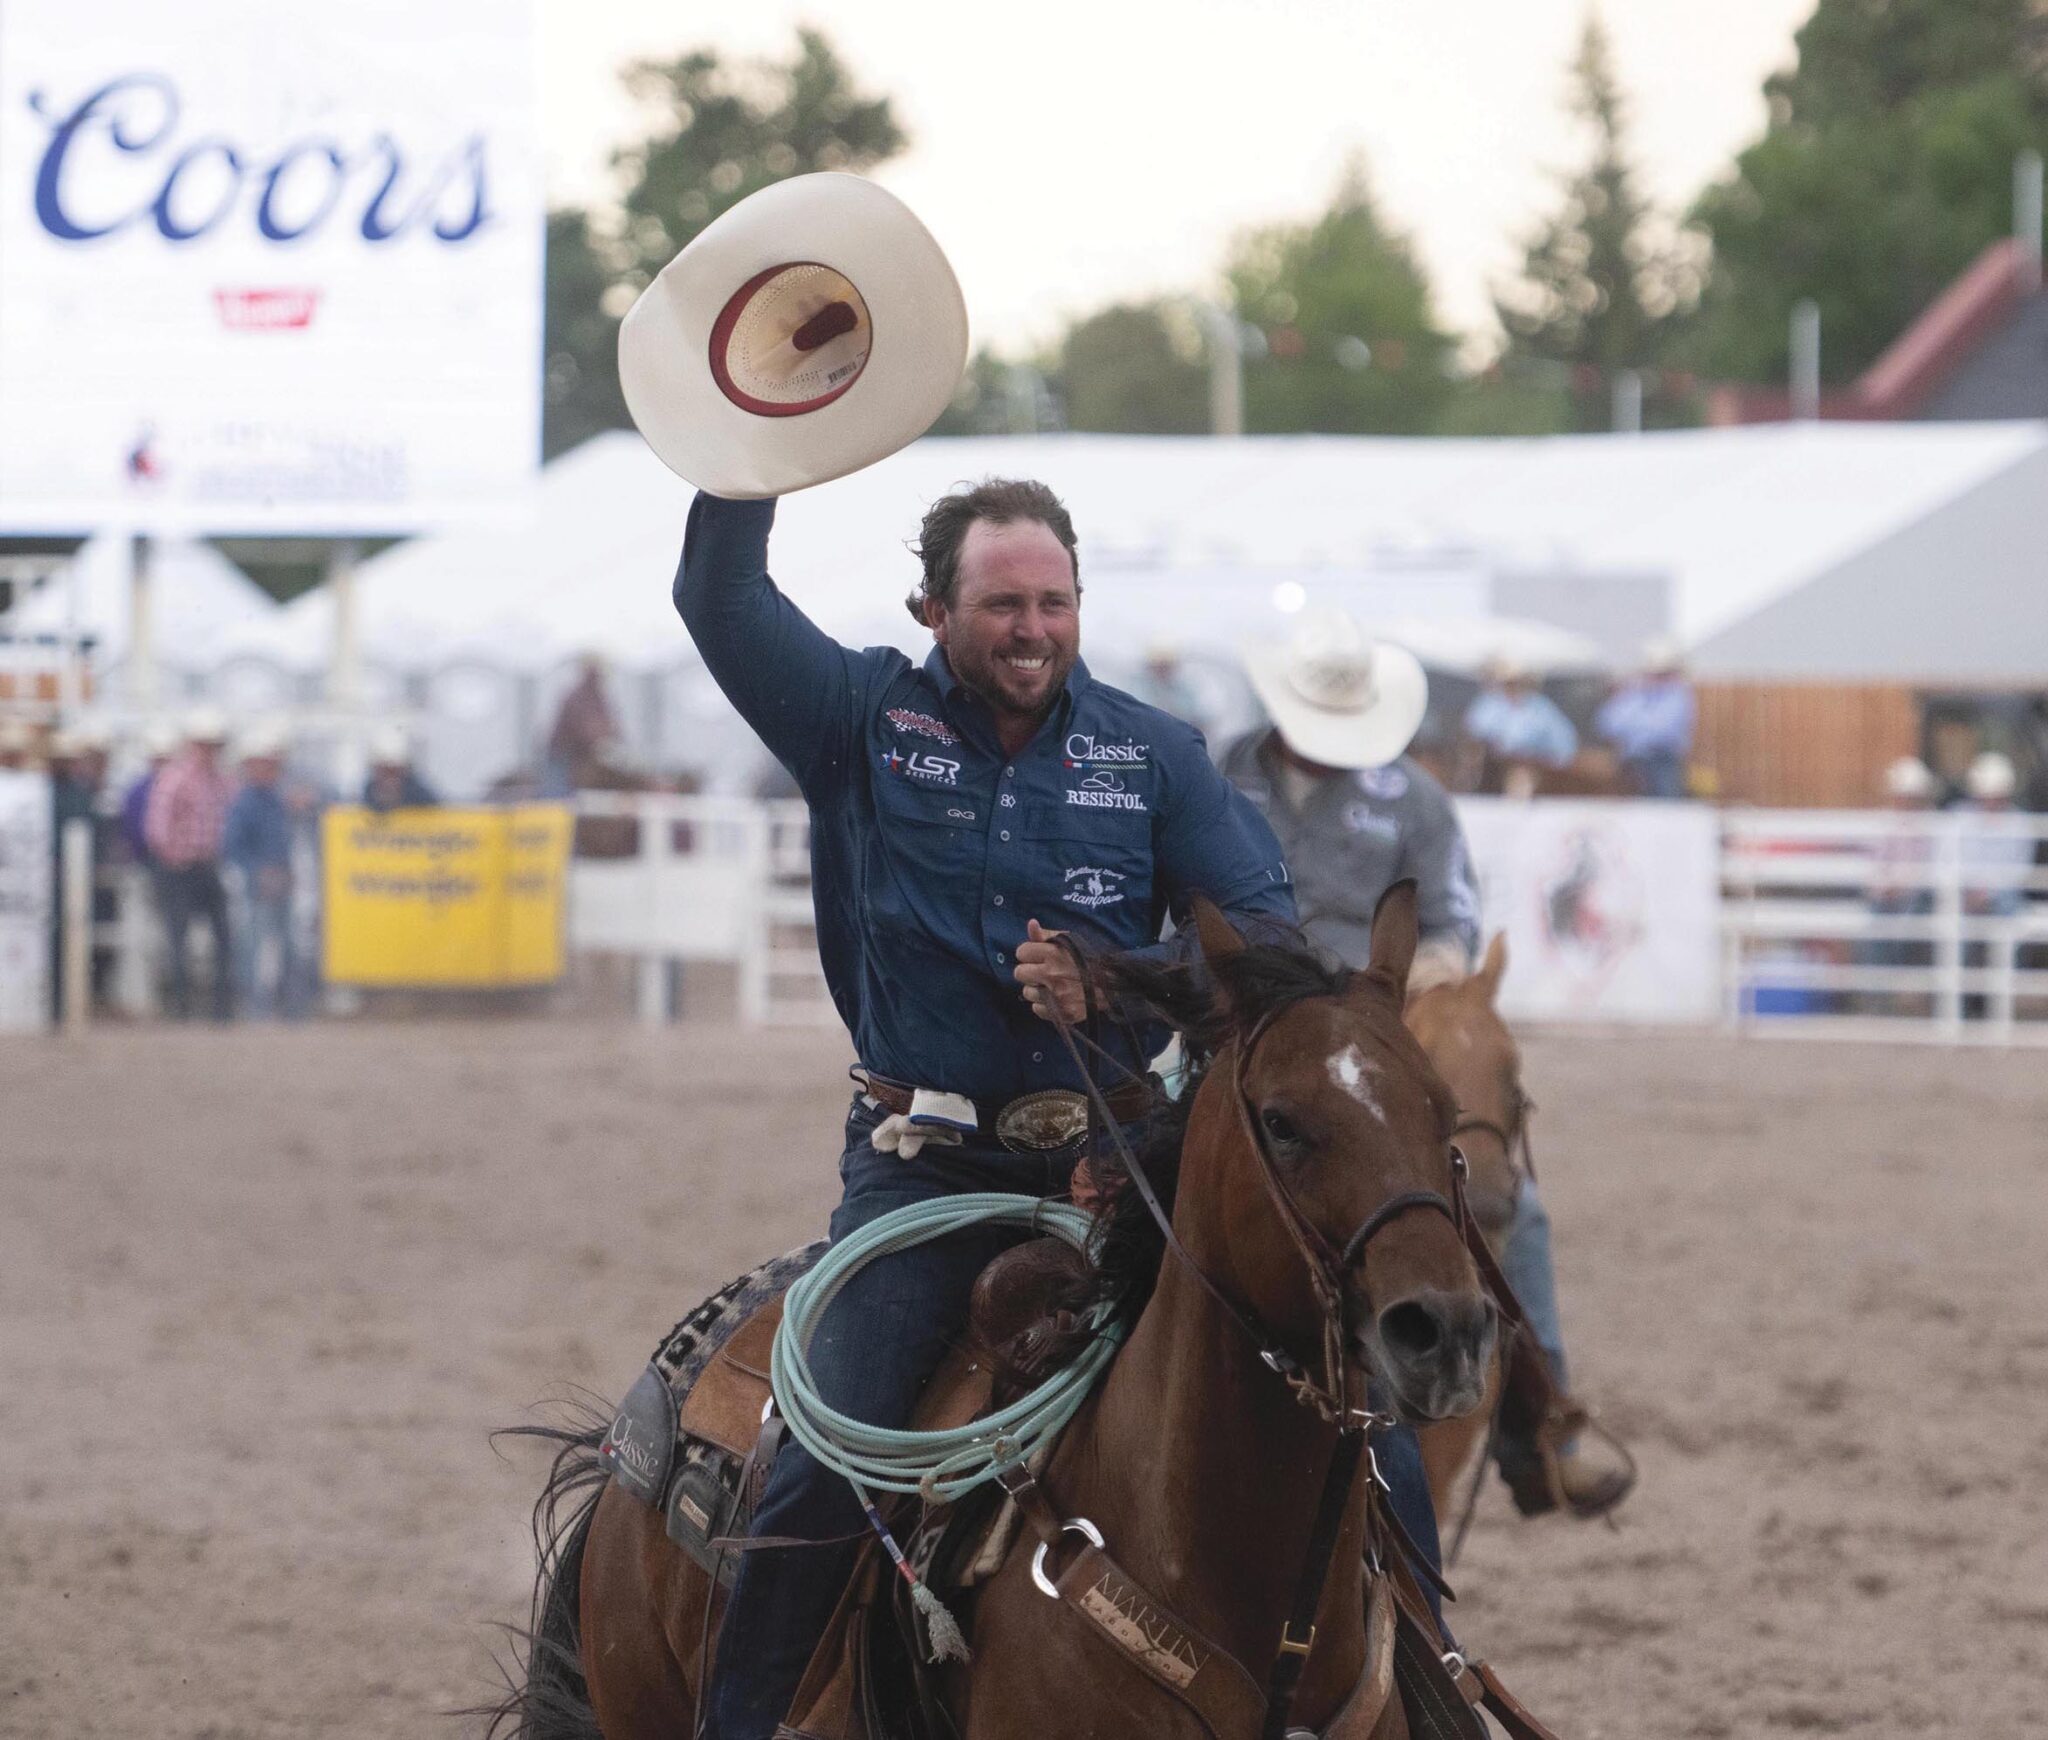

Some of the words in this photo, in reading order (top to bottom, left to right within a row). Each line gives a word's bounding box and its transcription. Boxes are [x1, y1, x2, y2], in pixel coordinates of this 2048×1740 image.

[27, 73, 493, 242] Coors
[1066, 733, 1147, 761] Classic
[905, 769, 957, 786] SERVICES
[908, 751, 960, 780] LSR
[1066, 790, 1143, 810] RESISTOL
[610, 1412, 658, 1478] Classic
